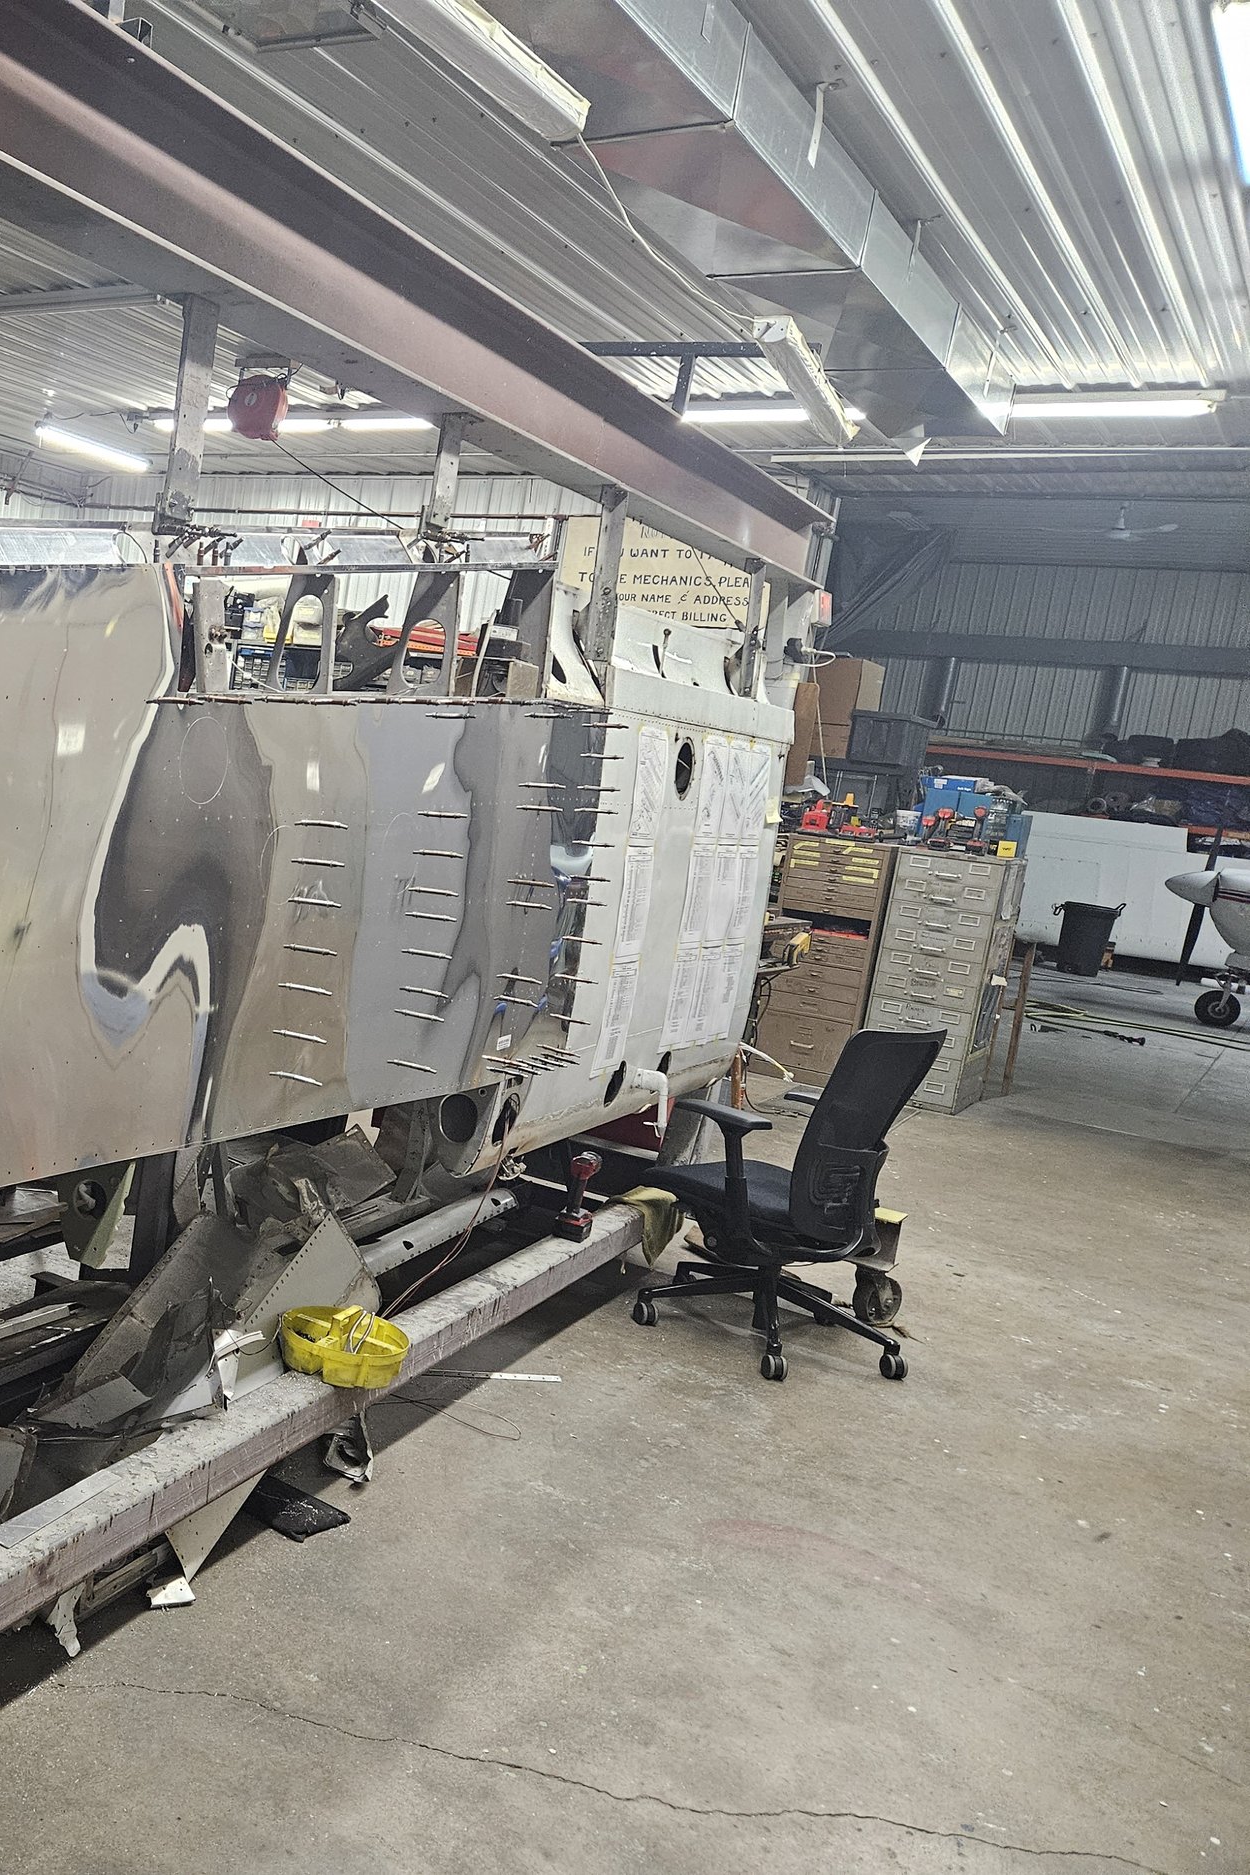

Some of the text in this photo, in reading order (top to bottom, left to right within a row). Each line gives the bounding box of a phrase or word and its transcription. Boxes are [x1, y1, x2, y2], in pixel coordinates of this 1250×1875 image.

[583, 546, 596, 557] IF
[630, 548, 670, 559] WANT
[676, 549, 692, 559] TO
[718, 576, 749, 588] PLEA
[641, 594, 671, 604] NAME
[693, 594, 750, 607] ADDRESS
[681, 611, 727, 623] BILLING
